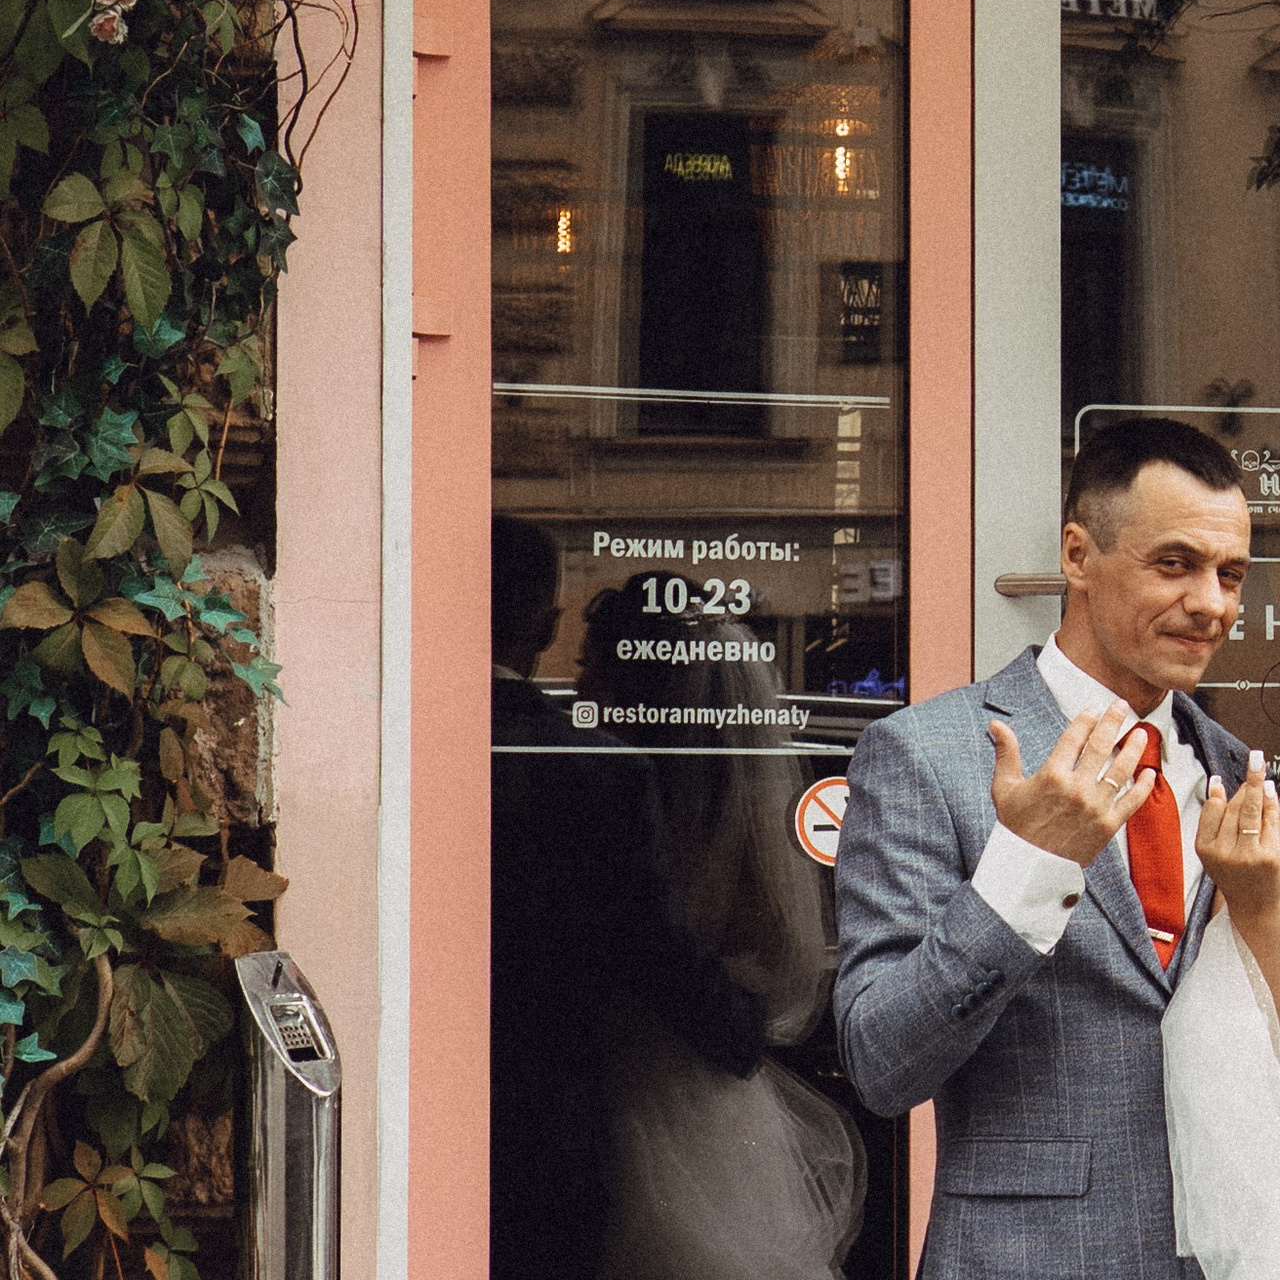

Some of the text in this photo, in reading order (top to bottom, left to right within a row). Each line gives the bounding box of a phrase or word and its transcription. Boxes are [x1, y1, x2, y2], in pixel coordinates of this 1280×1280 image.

[593, 531, 800, 565] Режим работы:
[642, 577, 751, 615] 10-23
[616, 639, 776, 665] ежедневно
[603, 703, 810, 730] restoranmyzhenaty
